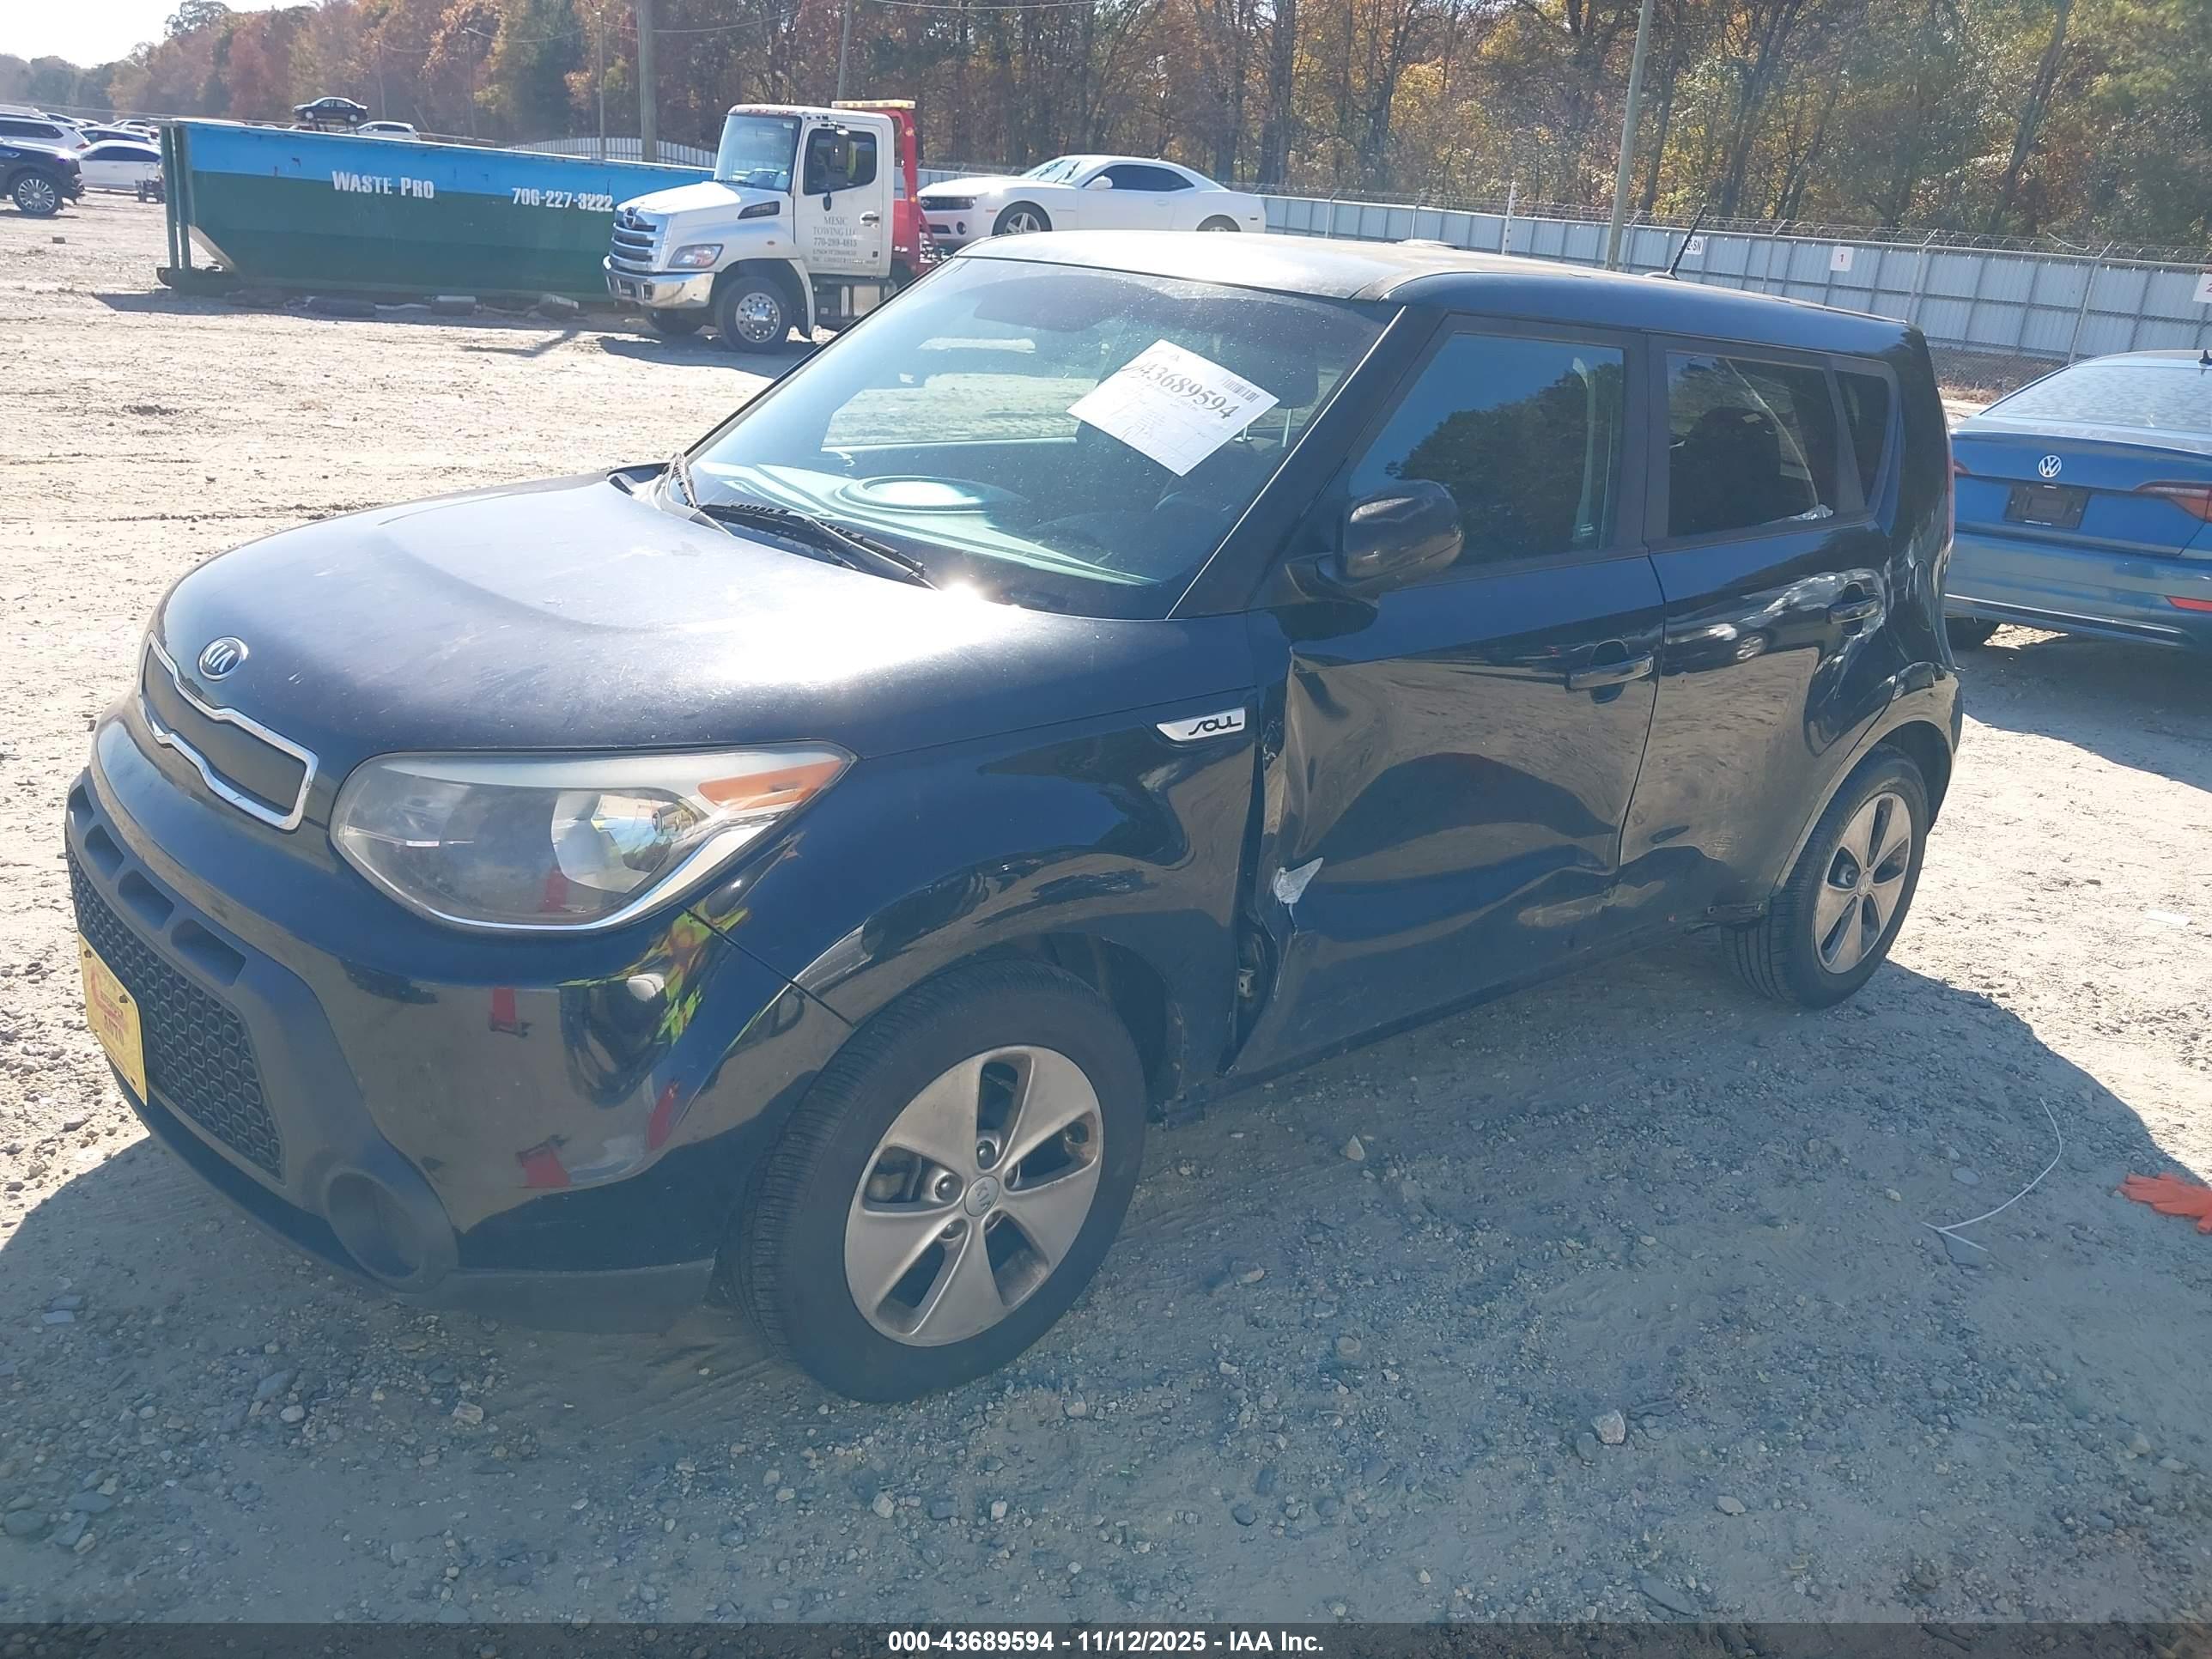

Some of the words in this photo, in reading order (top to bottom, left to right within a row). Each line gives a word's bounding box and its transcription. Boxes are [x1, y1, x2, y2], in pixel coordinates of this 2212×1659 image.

[331, 171, 392, 194] WASTE
[400, 177, 434, 199] PRO
[512, 187, 613, 212] 706-227-3222
[813, 226, 843, 236] TOWING
[1839, 253, 1844, 263] 1
[1188, 715, 1243, 737] SOUL
